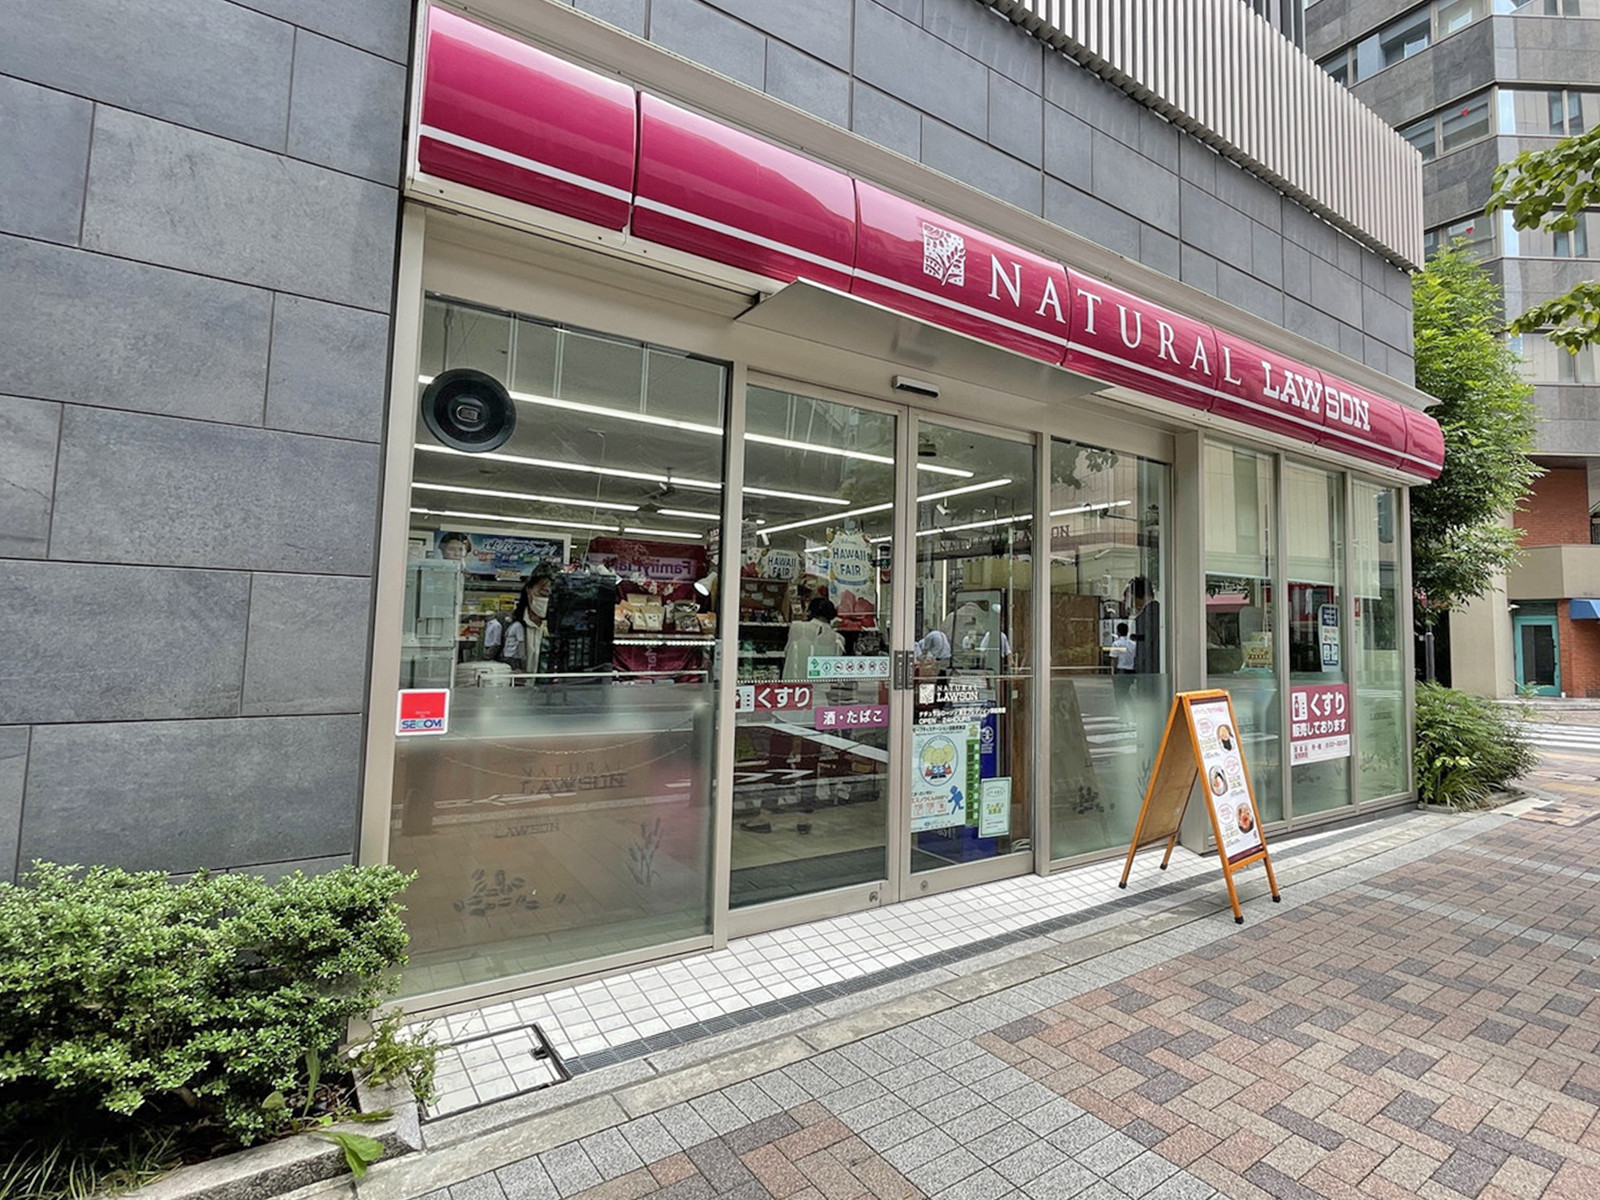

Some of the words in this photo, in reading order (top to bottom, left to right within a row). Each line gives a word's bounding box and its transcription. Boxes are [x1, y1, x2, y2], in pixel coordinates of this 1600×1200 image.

[988, 253, 1243, 386] NATURAL
[1261, 360, 1371, 431] LAWSON
[832, 547, 867, 561] HAWAII
[767, 555, 797, 567] HAWAII
[772, 567, 791, 577] FAIR
[840, 564, 861, 576] FAIR
[757, 686, 811, 709] くすり
[936, 691, 979, 702] LAWSON
[1310, 691, 1345, 717] くすり
[402, 718, 442, 729] SECOM
